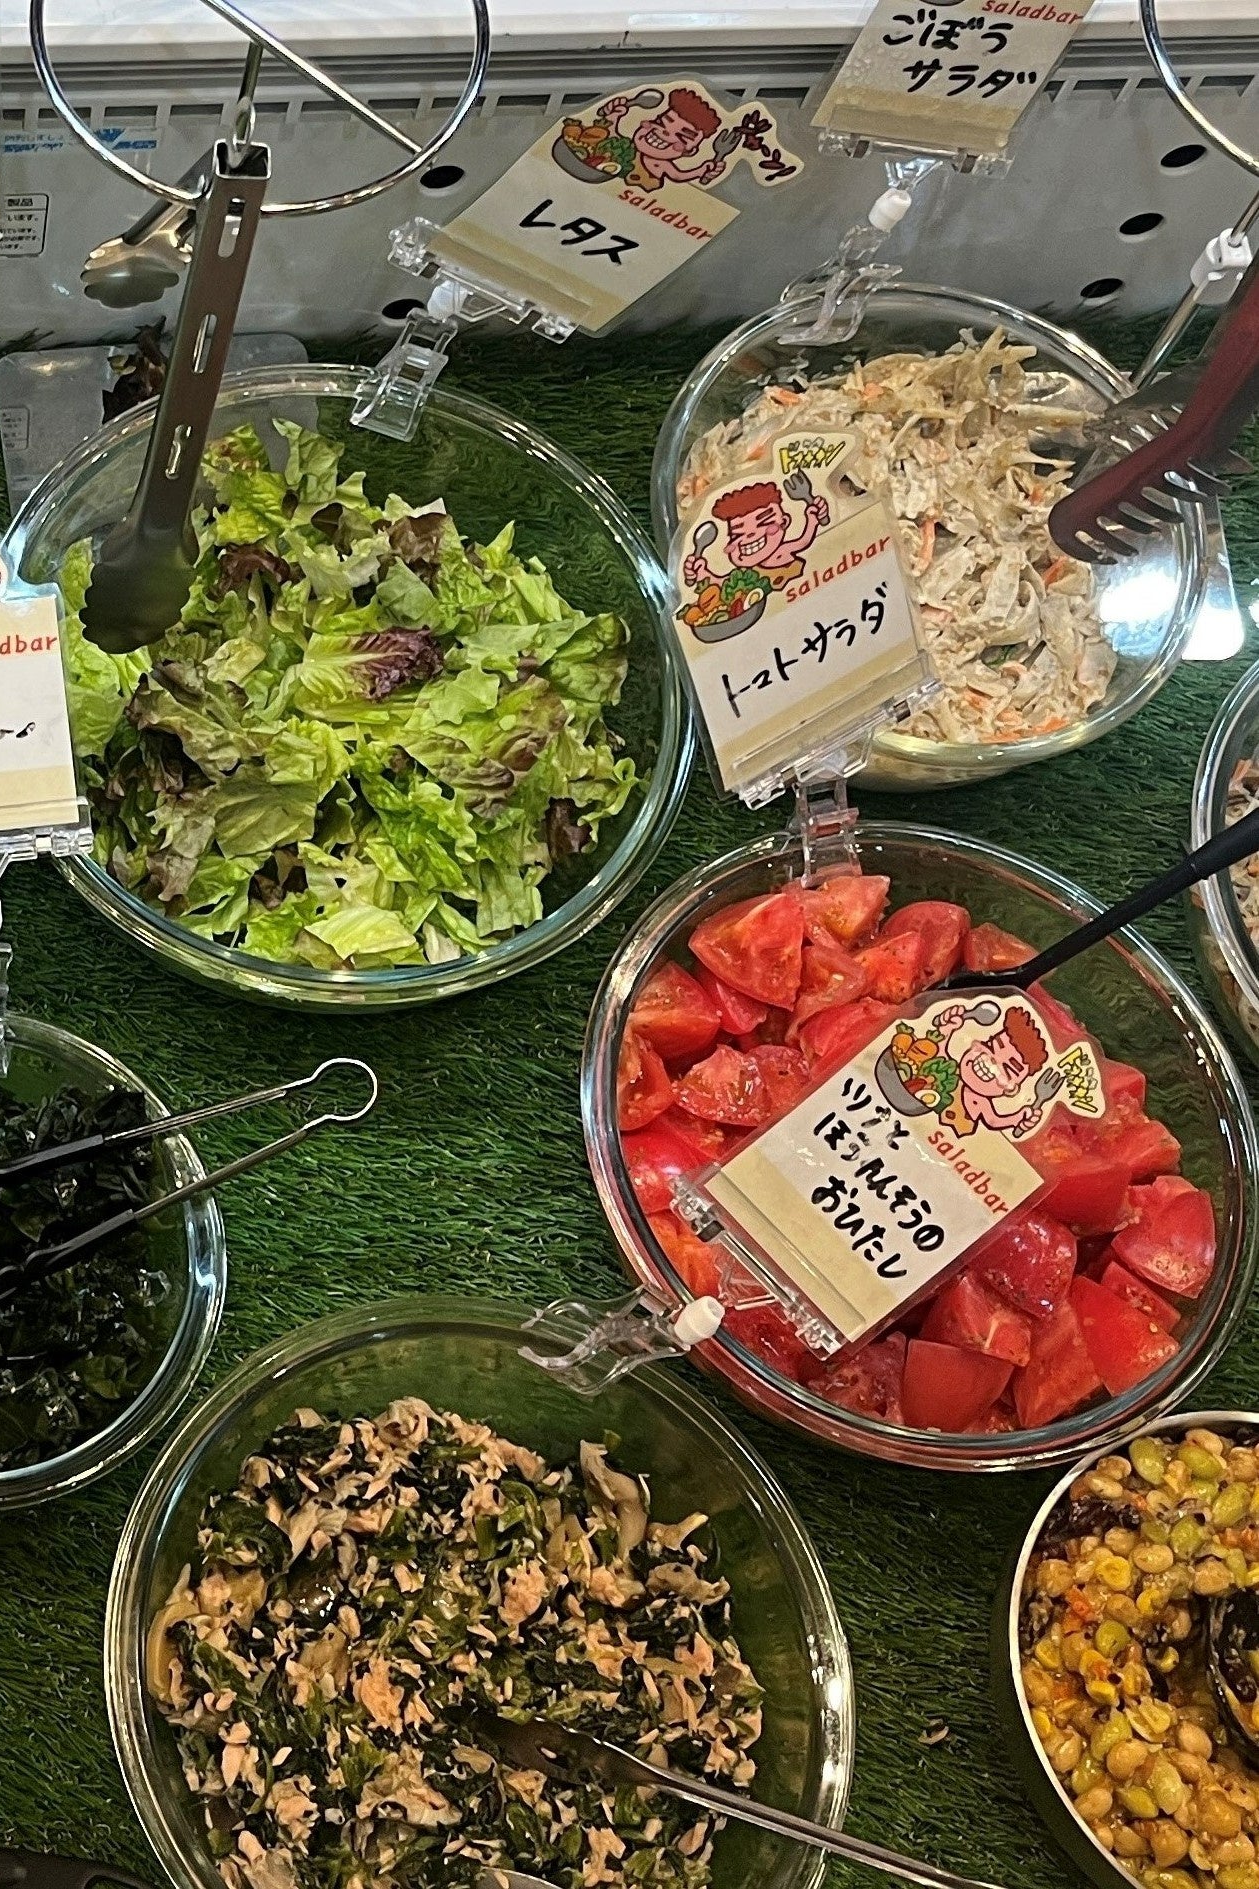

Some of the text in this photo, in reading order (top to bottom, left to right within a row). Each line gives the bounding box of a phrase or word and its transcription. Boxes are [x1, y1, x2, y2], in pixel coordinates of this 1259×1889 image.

[883, 9, 1014, 54] ごぼう
[982, 0, 1084, 25] saladbar
[903, 58, 1037, 98] サラダ
[519, 199, 640, 265] レタス
[617, 188, 714, 242] saladbar
[785, 534, 891, 604] saladbar
[722, 581, 889, 718] トマトサラダ
[928, 1129, 1008, 1215] saladbar
[811, 1175, 907, 1279] おひたし
